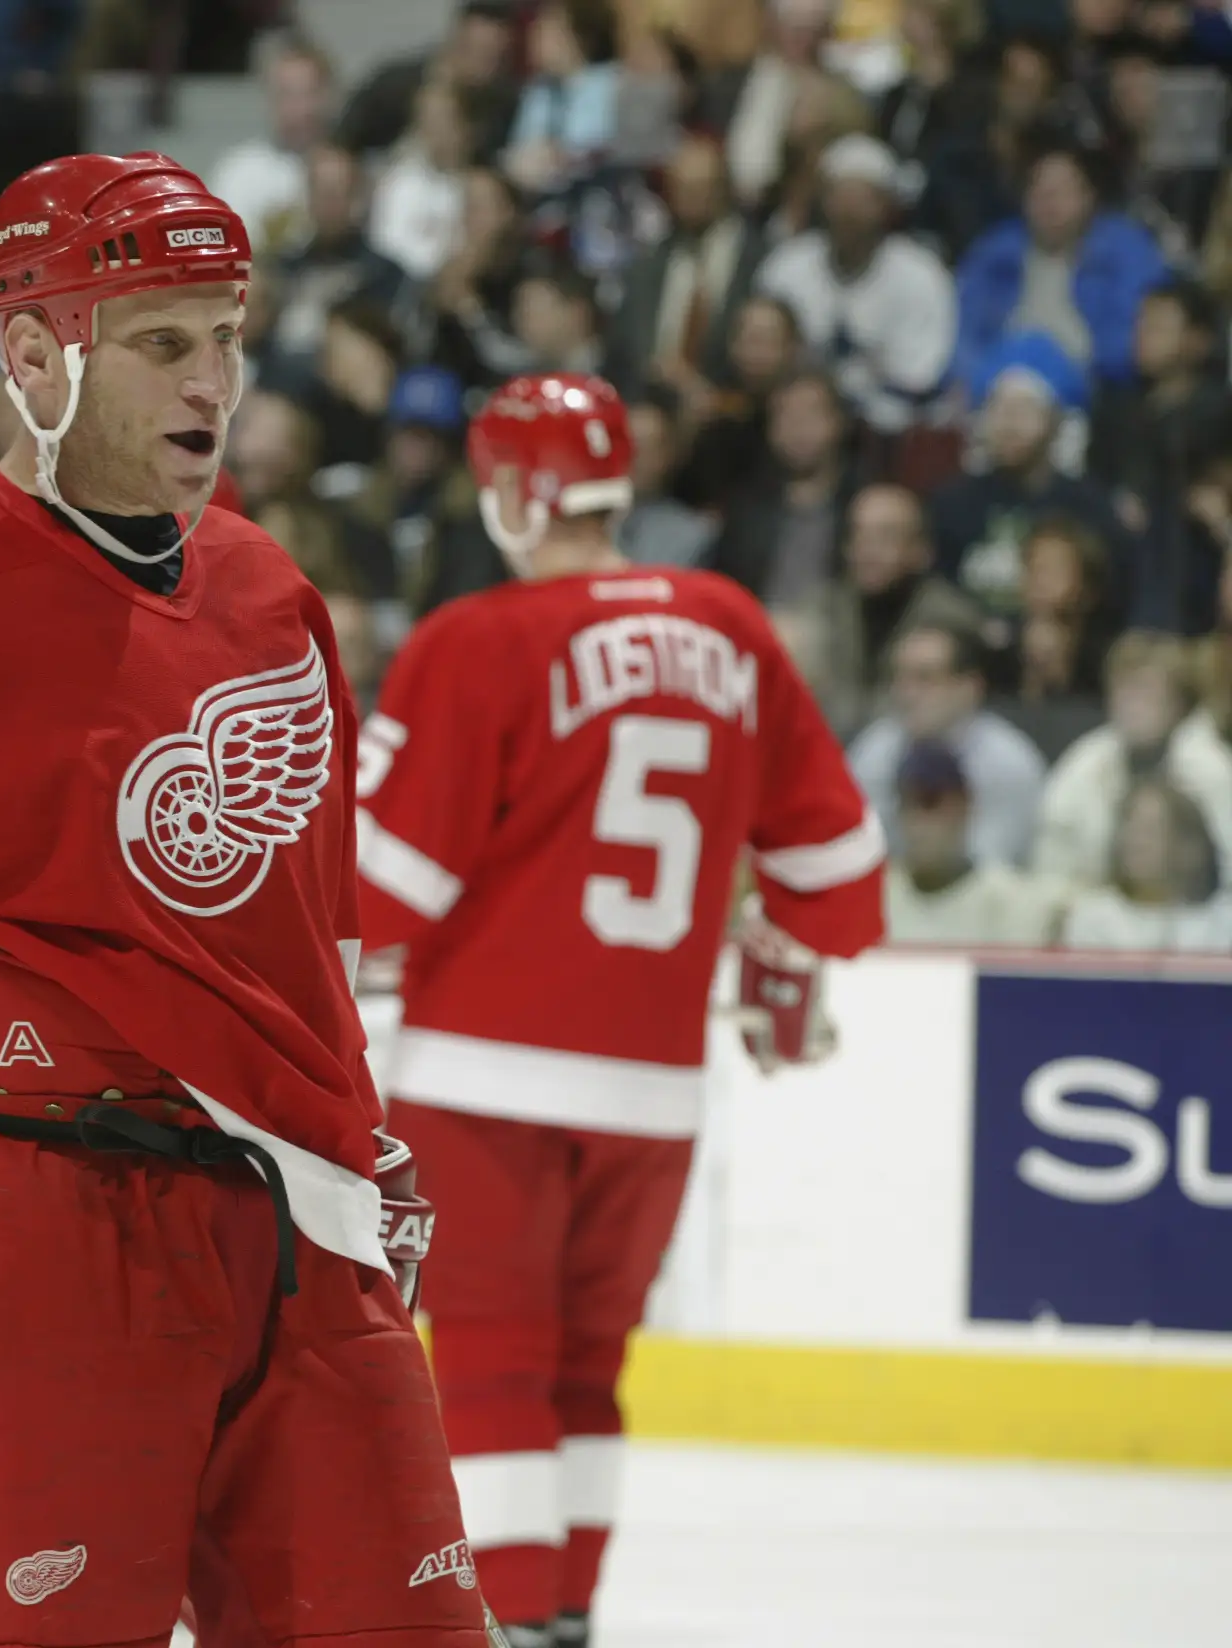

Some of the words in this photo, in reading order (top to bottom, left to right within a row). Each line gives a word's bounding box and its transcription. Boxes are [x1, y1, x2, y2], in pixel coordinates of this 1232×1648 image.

[11, 221, 49, 237] Wings
[170, 229, 223, 245] CCM
[581, 714, 712, 952] 5
